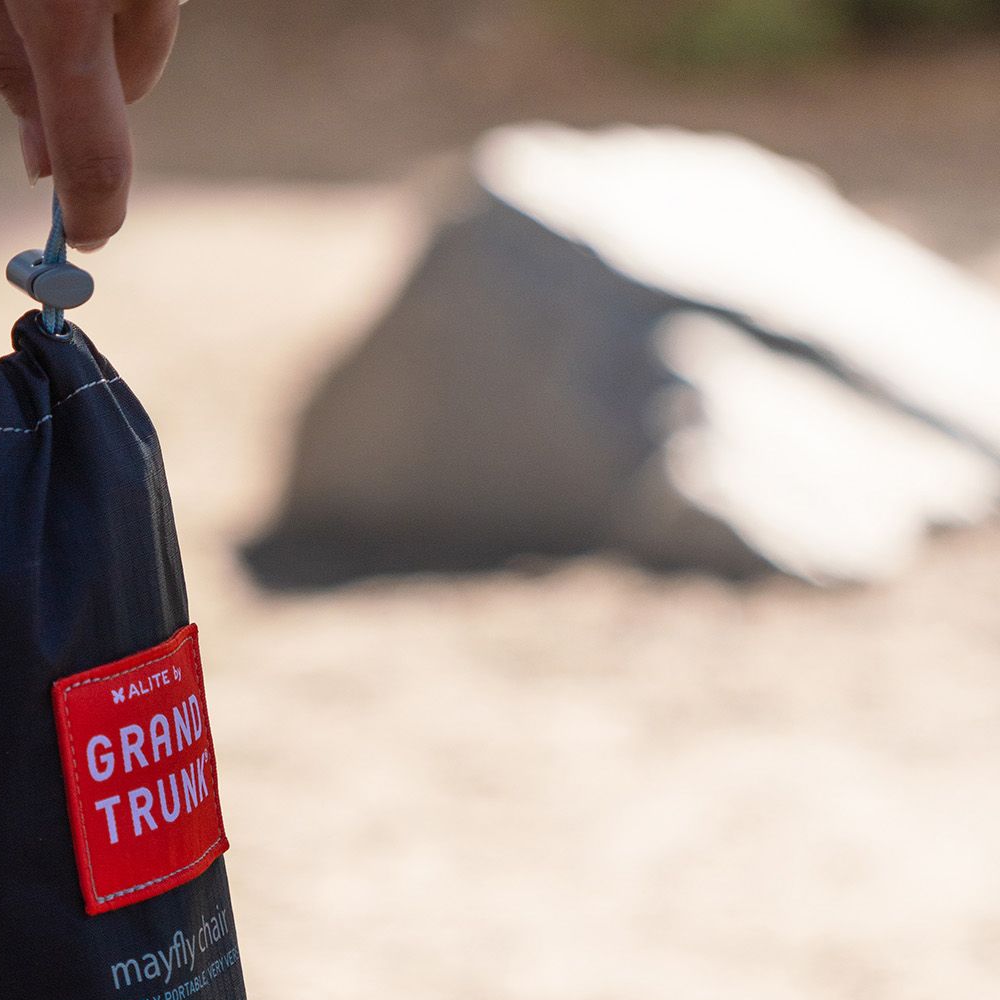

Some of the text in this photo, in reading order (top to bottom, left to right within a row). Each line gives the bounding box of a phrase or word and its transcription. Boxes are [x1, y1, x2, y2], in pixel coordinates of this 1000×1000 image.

[128, 667, 182, 700] ALITE by
[86, 694, 204, 783] GRAND
[111, 905, 229, 990] mayfly chair
[207, 957, 225, 980] VERY
